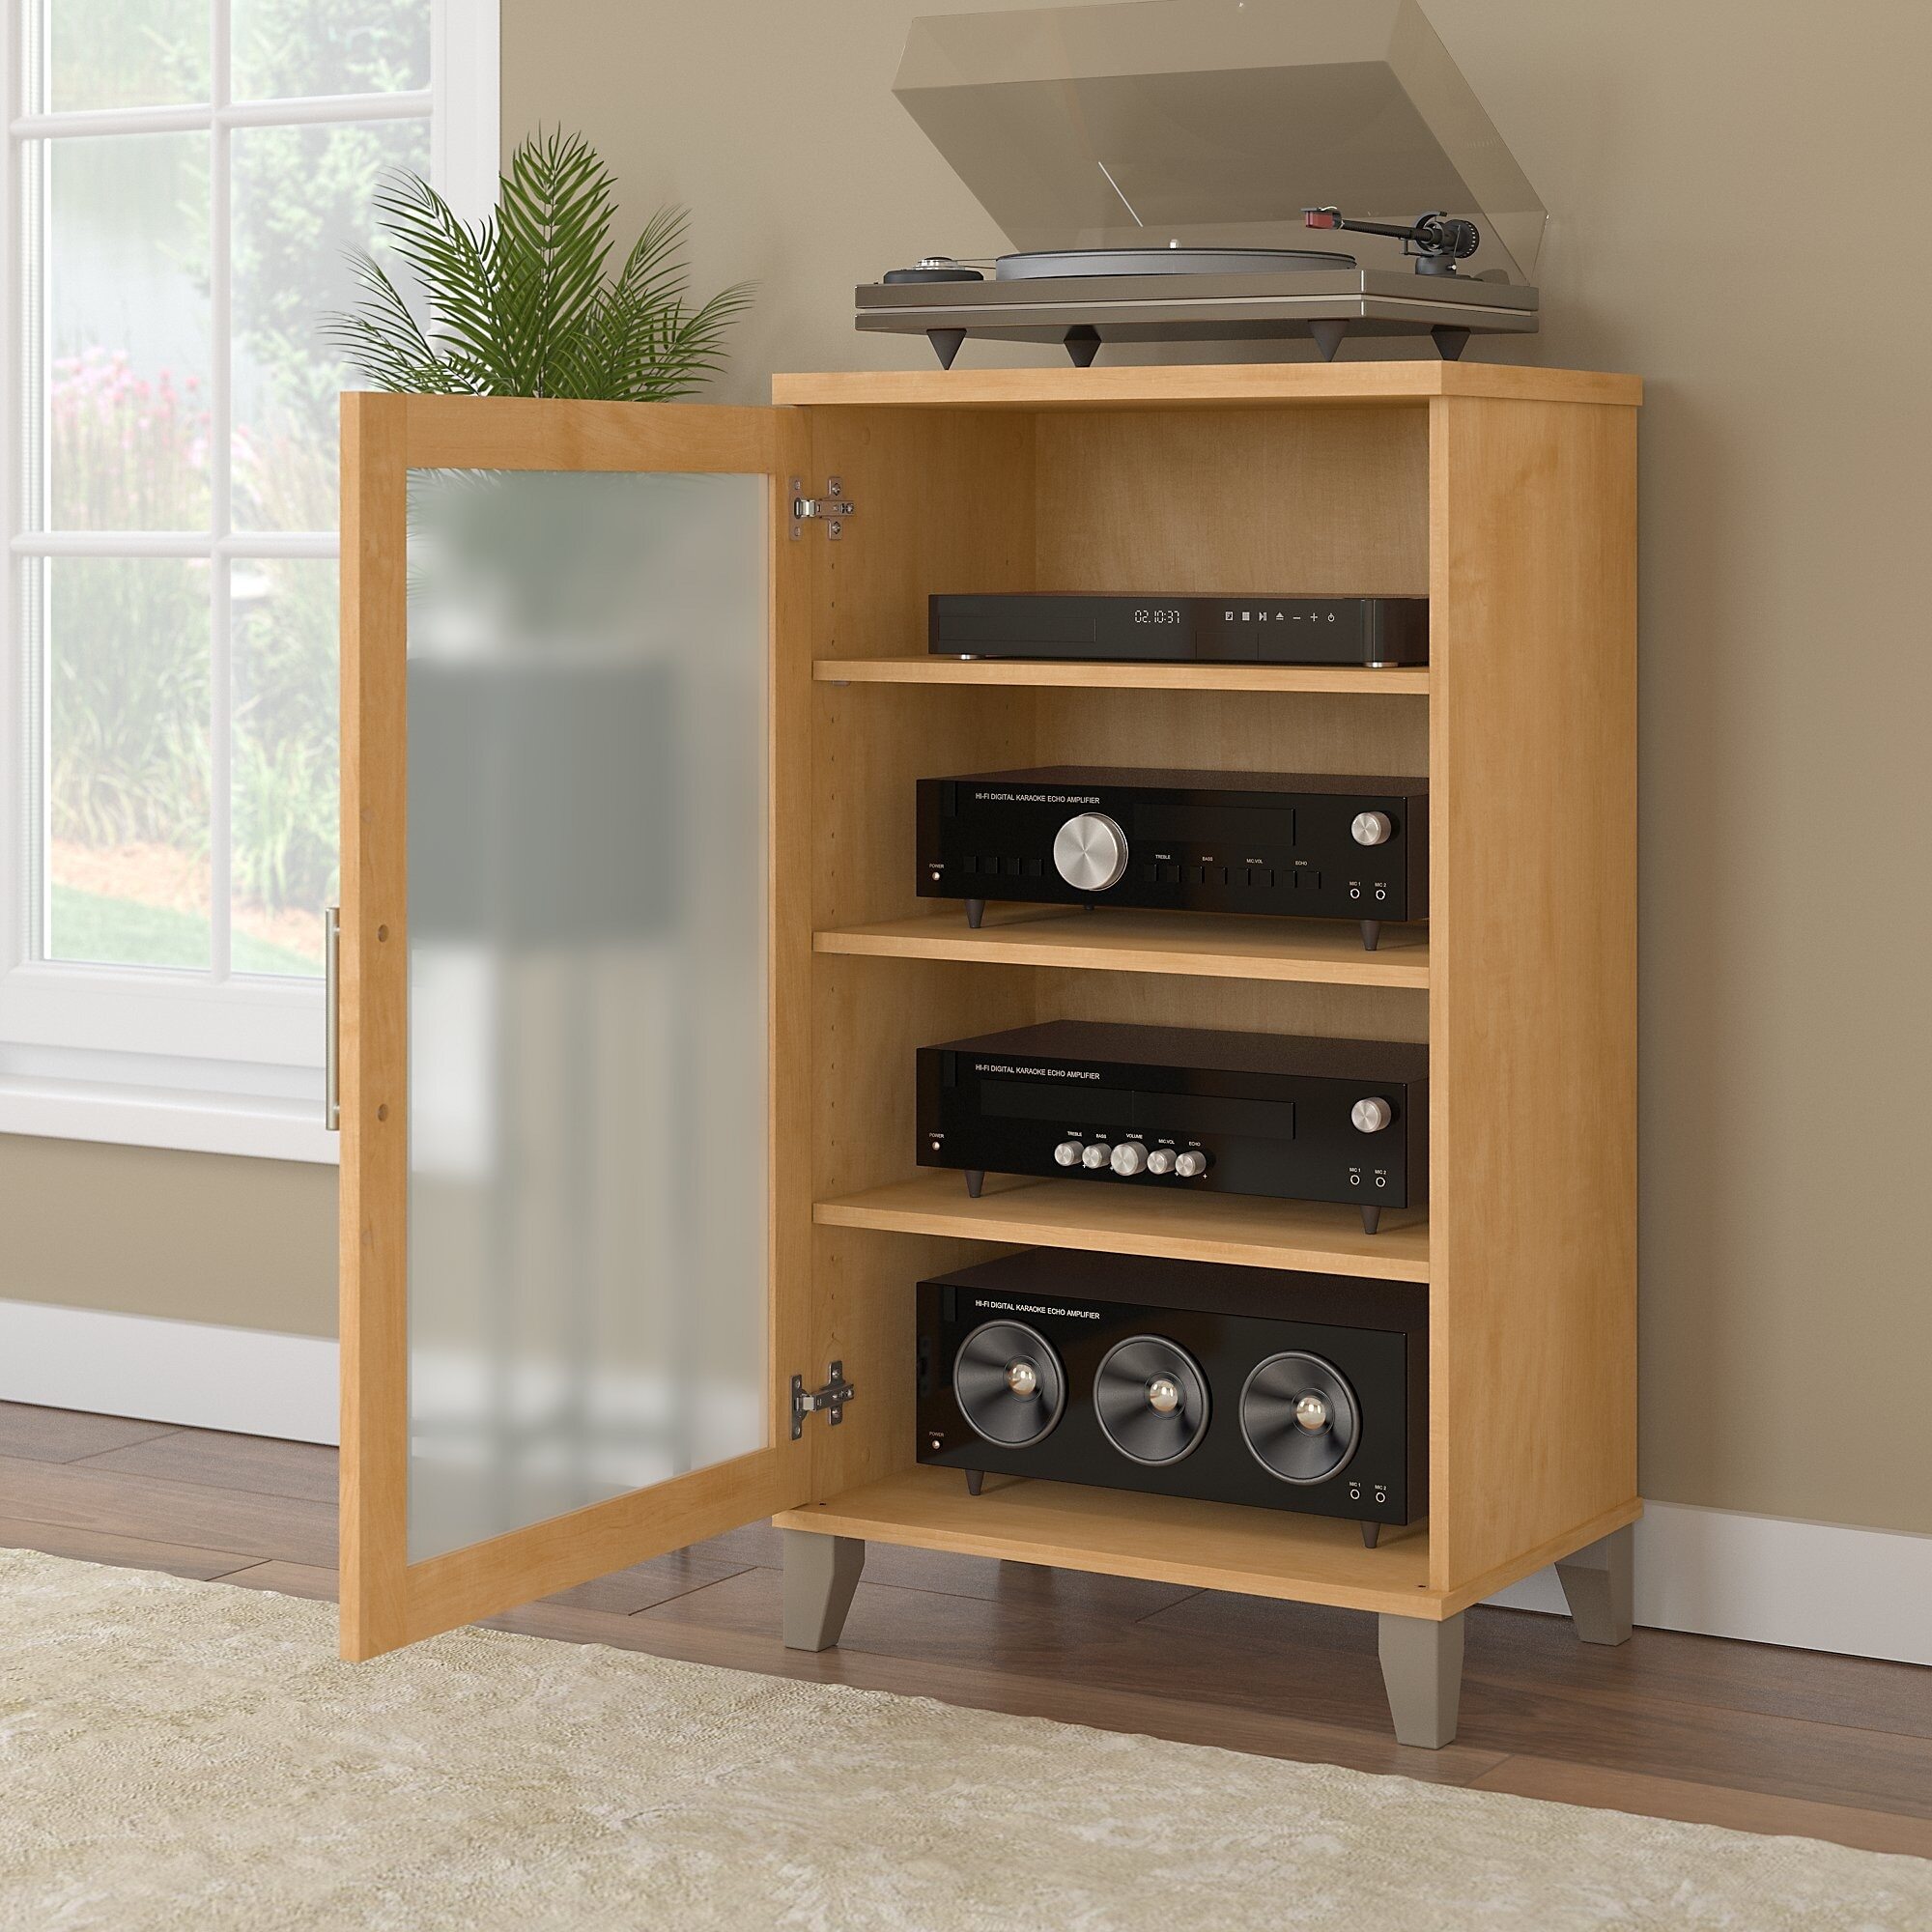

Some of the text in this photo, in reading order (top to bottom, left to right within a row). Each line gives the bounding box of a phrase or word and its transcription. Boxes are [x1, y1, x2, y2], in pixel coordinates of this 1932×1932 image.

[1015, 794, 1046, 803] KARAOKE
[990, 1065, 1015, 1073] DIGITAL
[1015, 1066, 1046, 1075] KARAOKE
[1047, 1068, 1065, 1077] ECHO
[1066, 1070, 1100, 1080] AMPLIFIER
[975, 1299, 1100, 1320] HI-FI DIGITAL KARAOKE ECHO AMPLIFIER
